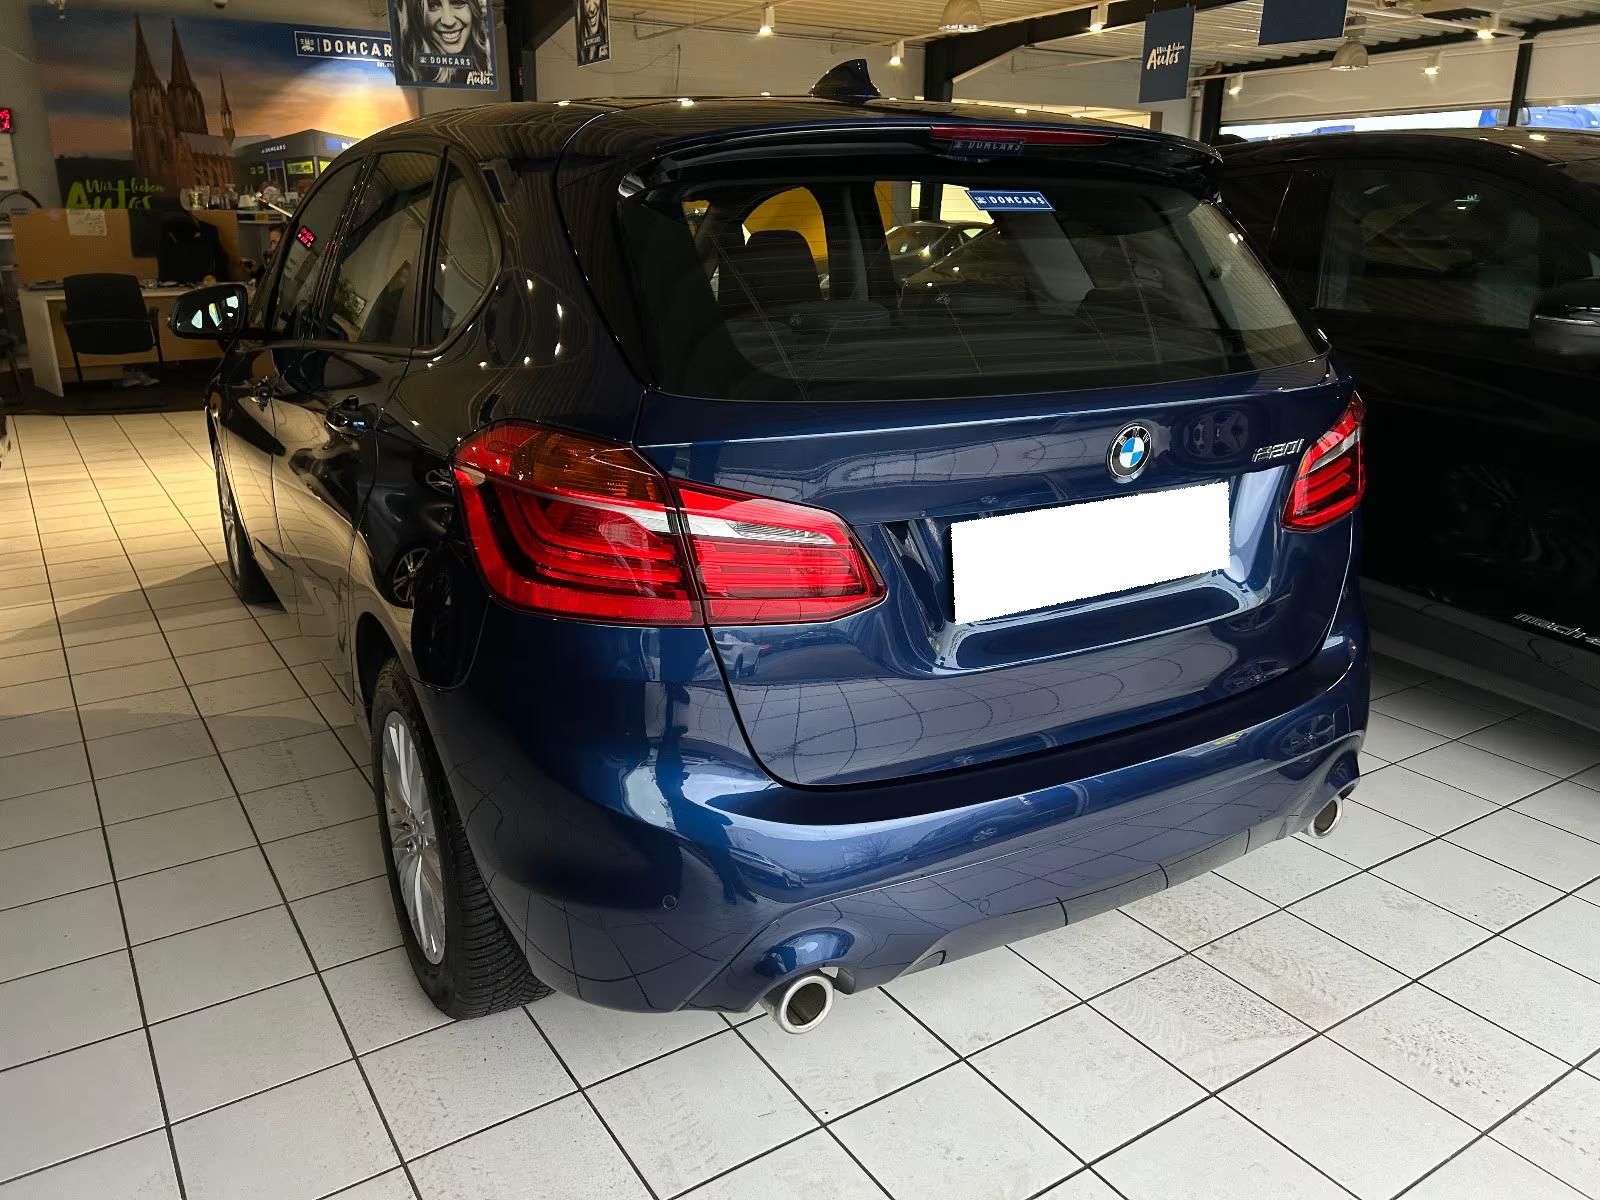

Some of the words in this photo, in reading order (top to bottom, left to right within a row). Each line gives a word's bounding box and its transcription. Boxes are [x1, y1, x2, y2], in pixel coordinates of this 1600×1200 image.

[430, 56, 471, 66] DOMCARS
[1146, 44, 1180, 70] Autos
[988, 196, 1045, 205] DOMCARS
